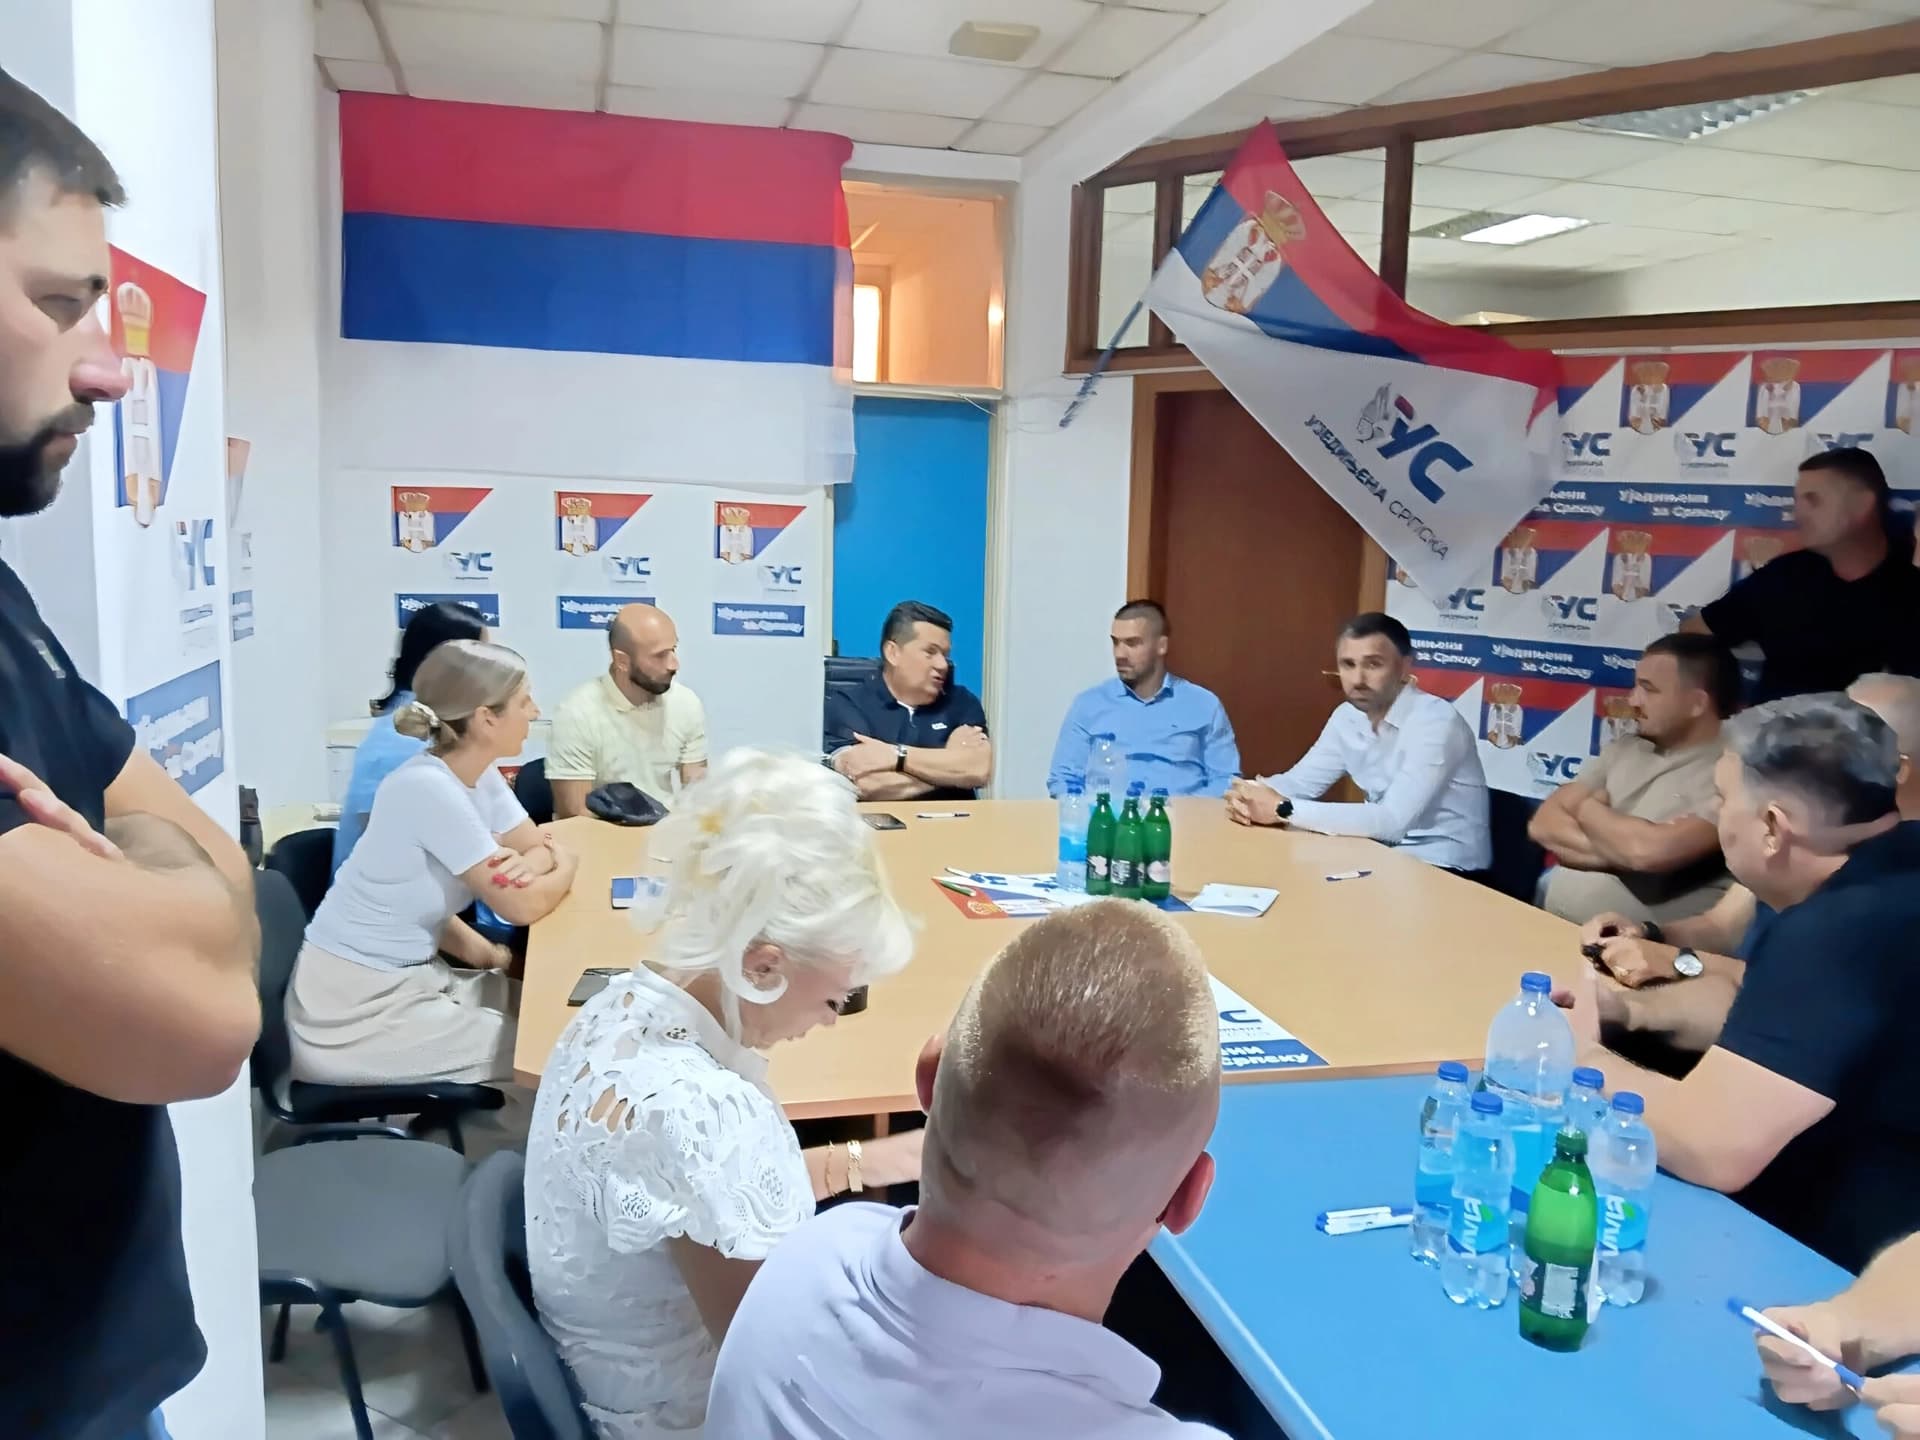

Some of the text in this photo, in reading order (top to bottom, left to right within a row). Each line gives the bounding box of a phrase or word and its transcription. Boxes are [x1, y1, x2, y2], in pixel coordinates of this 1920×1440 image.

[1377, 394, 1473, 504] УС
[1684, 432, 1736, 457] УС
[1388, 499, 1449, 560] СРПСКА
[1550, 594, 1598, 621] УС
[1535, 751, 1583, 780] УС
